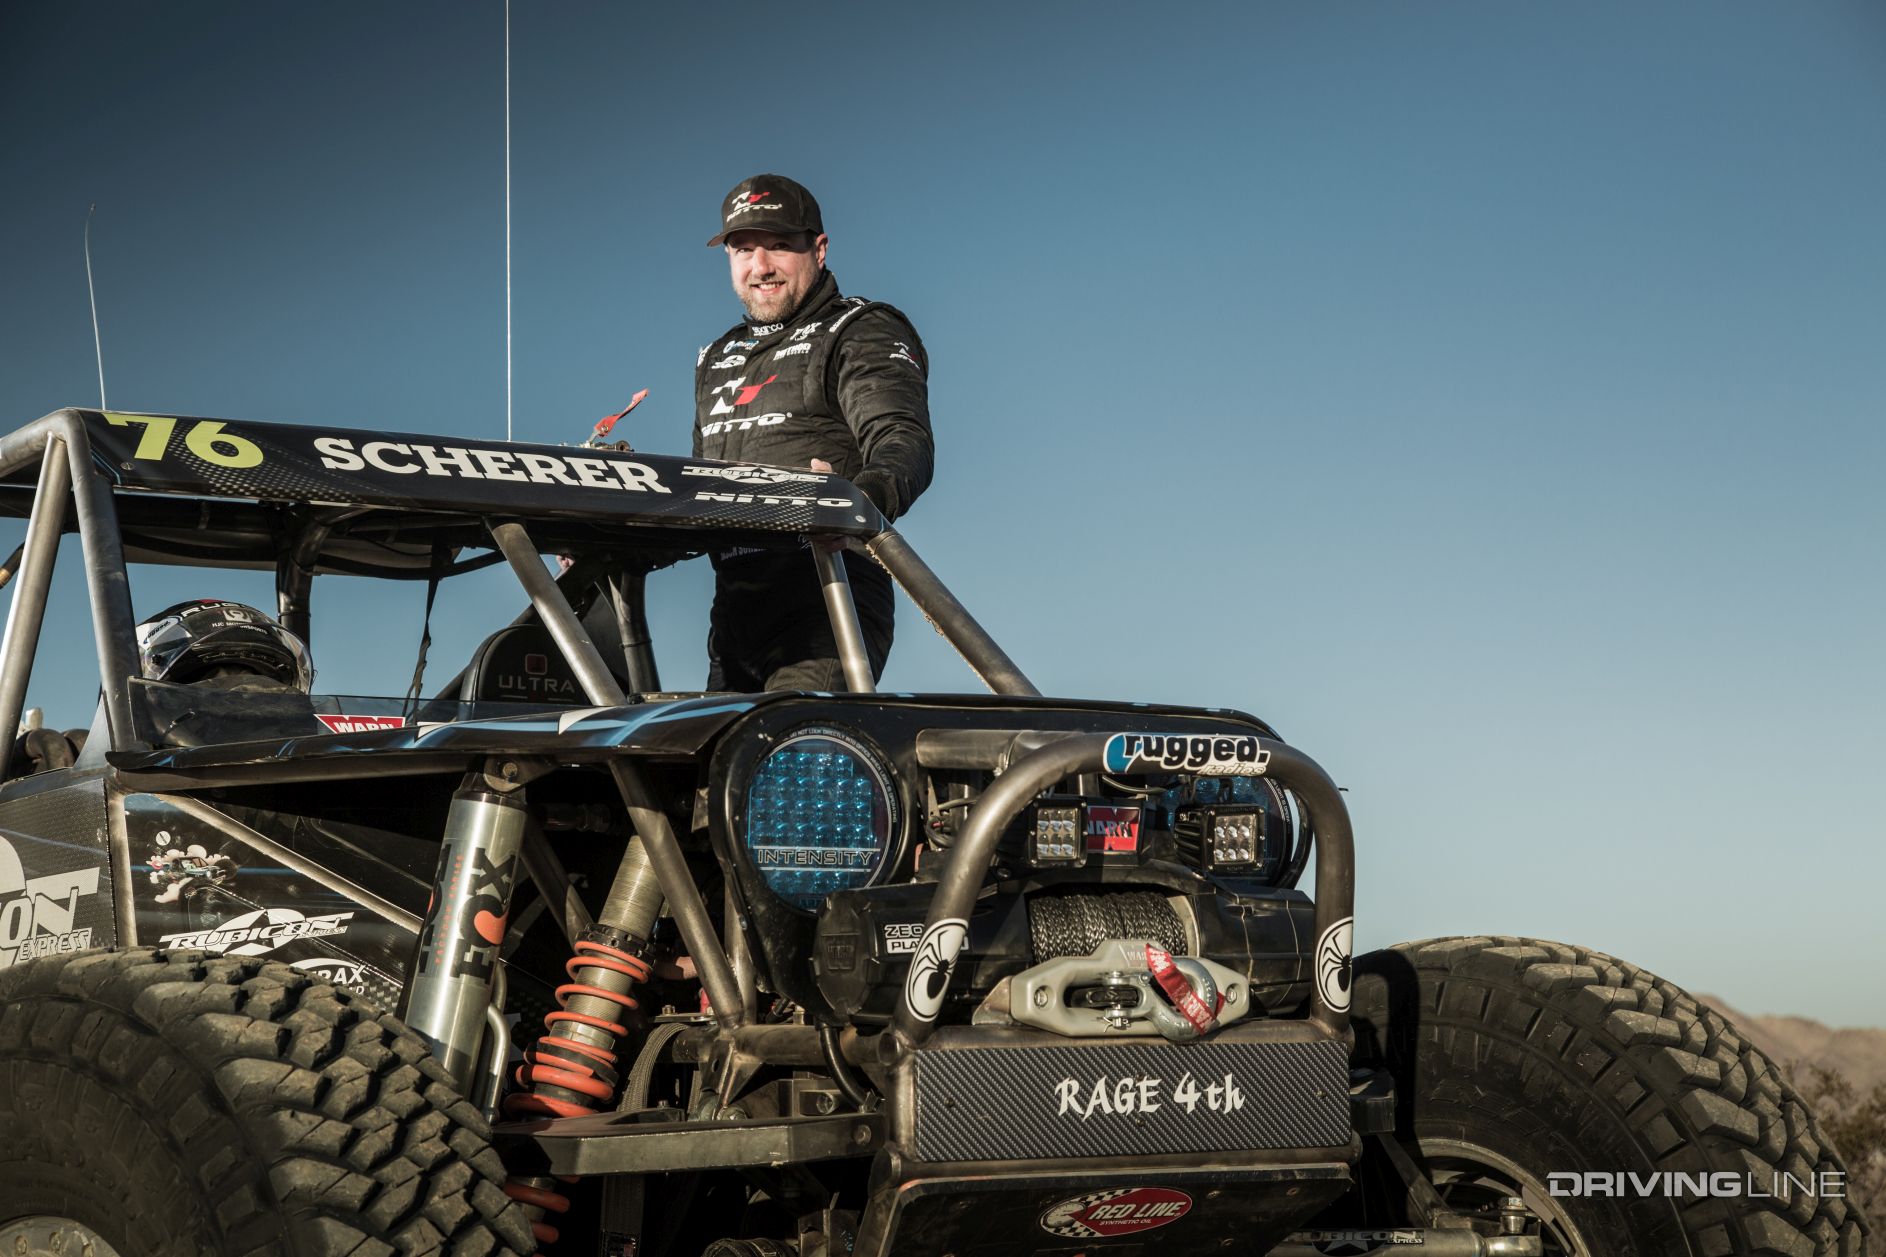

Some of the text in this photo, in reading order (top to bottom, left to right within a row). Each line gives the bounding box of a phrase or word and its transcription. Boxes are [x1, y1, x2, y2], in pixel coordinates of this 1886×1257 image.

[701, 413, 786, 437] NITTO
[102, 413, 264, 468] 76
[313, 437, 671, 494] SCHERER
[694, 492, 853, 507] NITTO
[498, 675, 575, 693] ULTRA
[757, 849, 874, 866] INTENSITY
[165, 916, 342, 950] RUBICON
[1055, 1071, 1246, 1122] RAGE 4th
[1088, 1202, 1187, 1220] RED LINE
